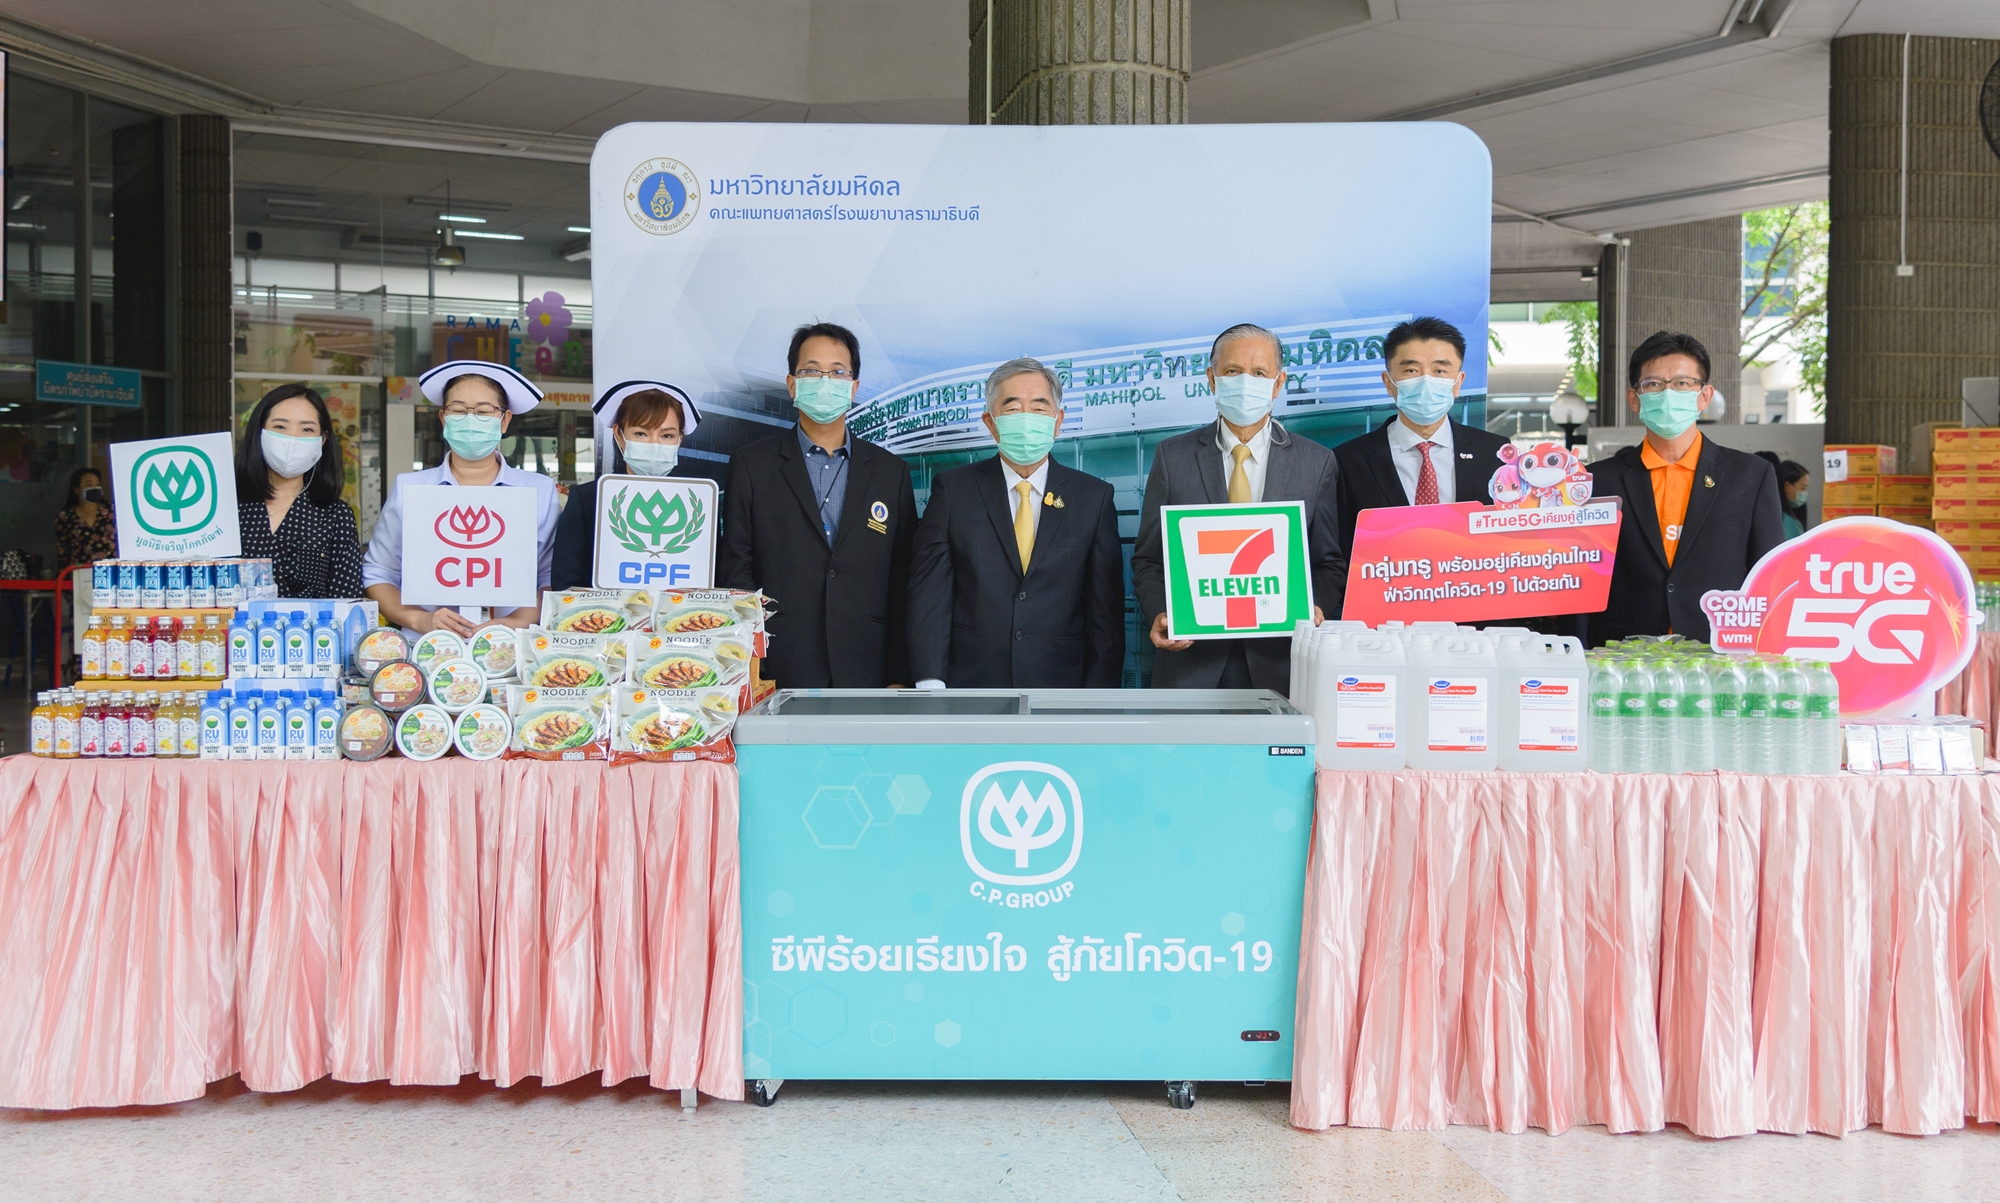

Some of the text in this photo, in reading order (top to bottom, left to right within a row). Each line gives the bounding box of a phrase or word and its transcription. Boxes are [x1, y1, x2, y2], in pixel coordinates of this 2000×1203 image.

[710, 174, 900, 196] มหาวิทยาลัยมหิดล
[710, 205, 980, 222] คณะแพทยศาสตร์โรงพยาบาลรามาธิบดี
[446, 315, 521, 332] RAMA
[1084, 386, 1166, 406] MAHIDOL
[1826, 459, 1841, 468] 19
[1476, 508, 1610, 528] #True5Gเคียงคู่สู้โควิด
[135, 526, 224, 554] มูลนิธิเจริญโภคภัณฑ์
[1362, 546, 1600, 582] กลุ่มทรู พร้อมอยู่เคียงคู่คนไทย
[435, 557, 502, 588] CPI
[619, 562, 690, 585] CPF
[1806, 554, 1915, 594] true
[1384, 574, 1580, 602] ฝ่าวิกฤตโควิด-19 ไปด้วยกัน
[1706, 596, 1766, 612] COME
[1714, 612, 1761, 626] TRUE
[1722, 633, 1752, 644] WITH
[1782, 598, 1930, 664] 5G
[666, 636, 712, 644] NOODLE
[233, 648, 247, 658] RU
[261, 648, 275, 658] RU
[289, 648, 303, 658] RU
[317, 648, 331, 658] RU
[205, 730, 219, 739] RU
[234, 730, 248, 739] RU
[262, 730, 276, 739] RU
[290, 730, 304, 739] RU
[320, 730, 334, 739] RU
[969, 880, 1075, 908] C.P.GROUP
[772, 932, 1273, 982] ซีพีร้อยเรียงใจ สู้ภัยโควิด-19
